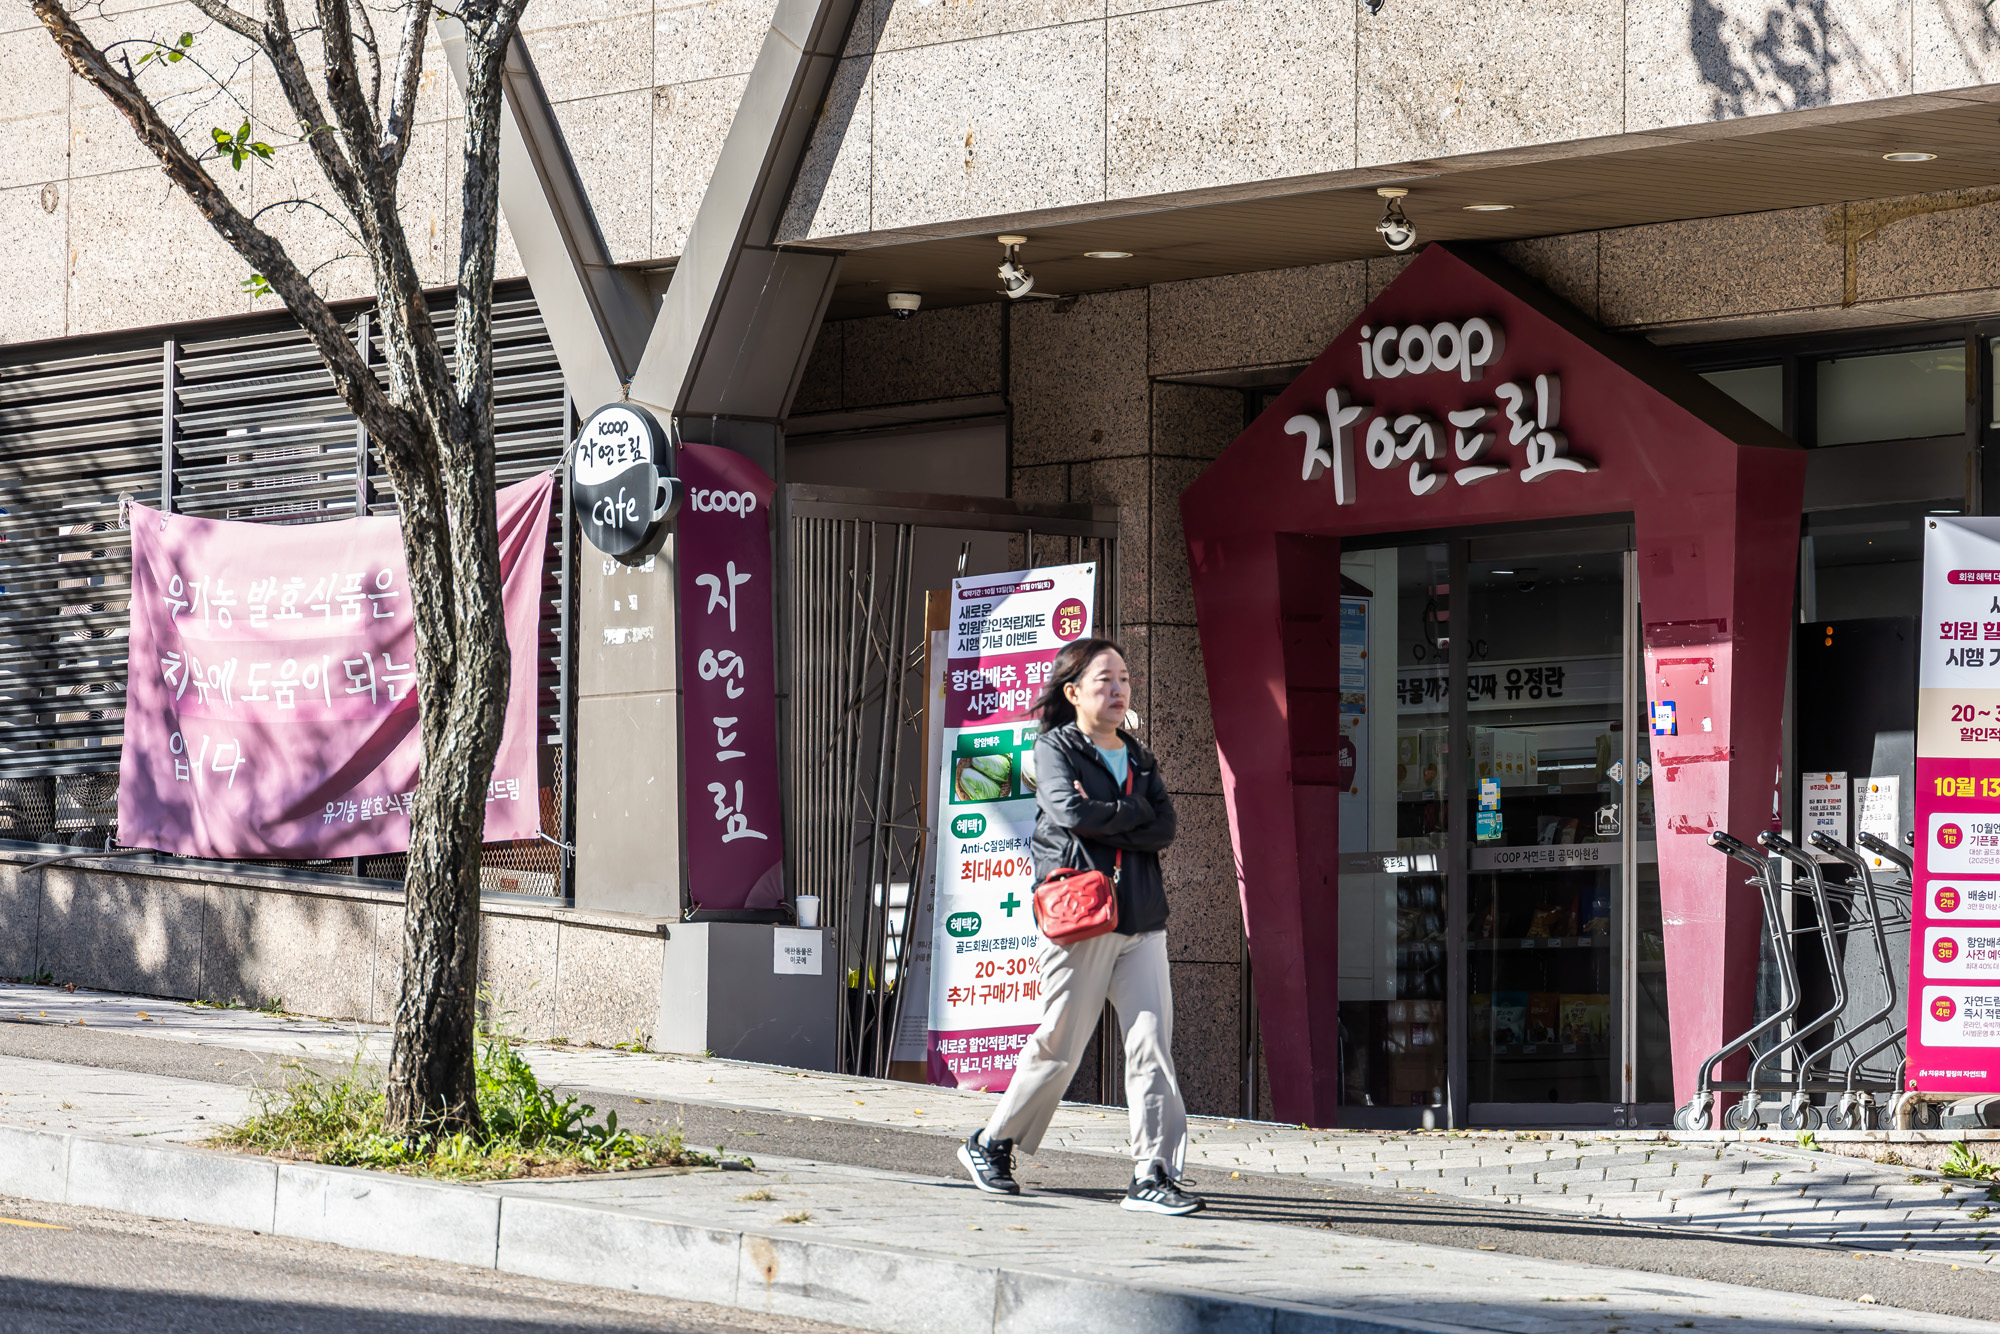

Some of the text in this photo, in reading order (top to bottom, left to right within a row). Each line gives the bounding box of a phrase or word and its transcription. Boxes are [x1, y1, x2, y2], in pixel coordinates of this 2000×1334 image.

[1358, 317, 1500, 382] icoop
[598, 420, 629, 437] icoop
[1284, 374, 1594, 505] 자연드림
[579, 435, 647, 468] 자연드림
[591, 487, 640, 529] cafe
[691, 487, 757, 519] icoop
[1958, 572, 1975, 582] 회원
[163, 567, 400, 629] 유기농 발효식품은
[959, 603, 993, 620] 새로운
[1060, 604, 1082, 617] 이벤트
[1060, 619, 1082, 636] 3탄
[1940, 621, 1978, 640] 회원
[957, 631, 1038, 652] 시행 기념 이벤트
[1946, 647, 1984, 667] 시행
[161, 650, 416, 710] 치유에 도움이 되는
[951, 664, 1022, 691] 항암배추,
[1503, 665, 1566, 700] 유정란
[695, 560, 768, 844] 자연드림
[967, 688, 1033, 715] 사전예약
[169, 731, 246, 790] 입니다
[1934, 777, 1976, 798] 10월
[322, 799, 359, 824] 유기농
[956, 818, 983, 834] 혜택1
[1943, 834, 1957, 844] 1탄
[1493, 848, 1600, 863] iCOOP 자연드림 공덕아현점
[961, 857, 1032, 883] 최대40%
[1940, 898, 1955, 908] 2탄
[1967, 890, 1997, 901] 배송비
[950, 917, 979, 933] 혜택2
[955, 936, 1020, 954] 골드회원(조합원)
[1938, 948, 1953, 958] 3탄
[1965, 949, 1986, 960] 사전
[975, 957, 1040, 979] 20~30%
[947, 985, 977, 1007] 추가
[979, 981, 1020, 1005] 구매가
[1935, 1008, 1950, 1017] 4탄
[1964, 1008, 1983, 1019] 즉시
[936, 1038, 968, 1055] 새로운
[948, 1058, 958, 1074] 더
